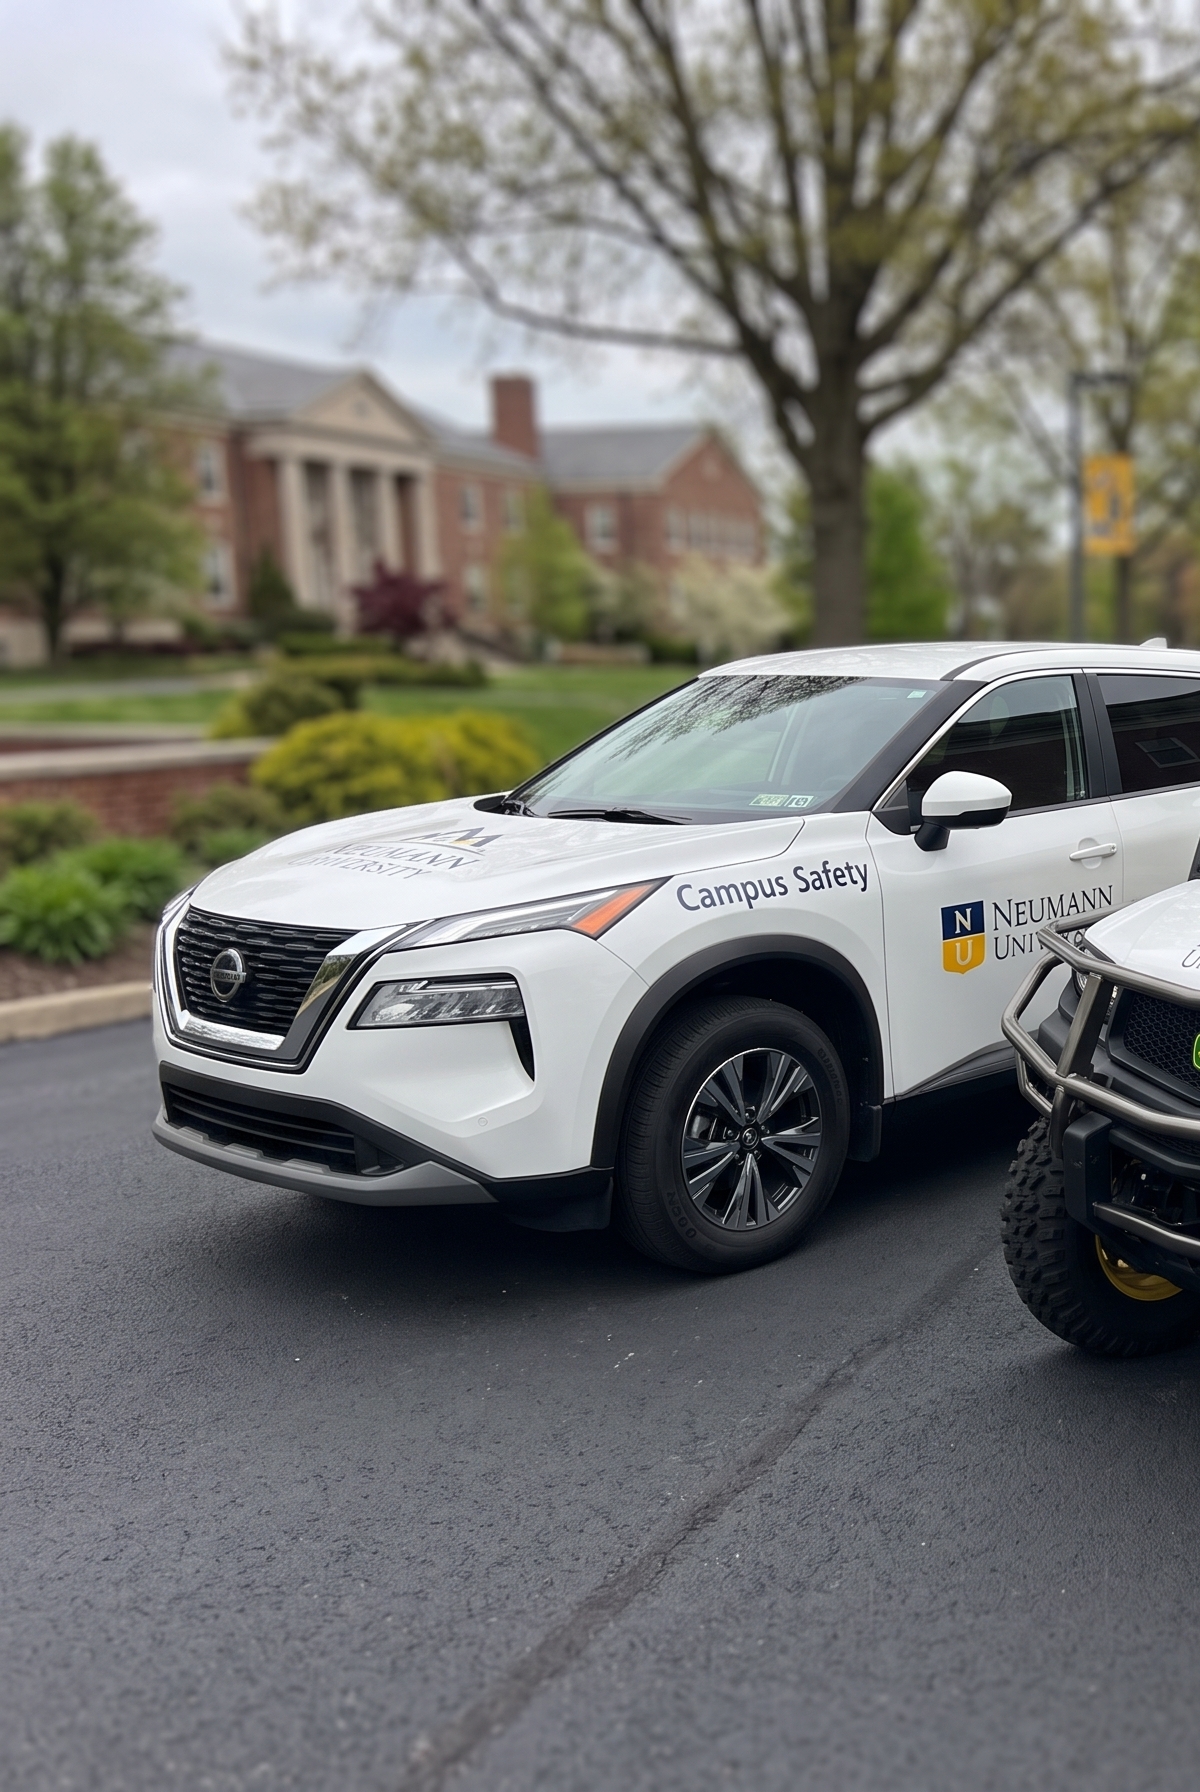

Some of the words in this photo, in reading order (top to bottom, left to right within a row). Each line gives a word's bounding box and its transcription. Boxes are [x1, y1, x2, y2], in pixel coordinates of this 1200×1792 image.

[676, 875, 789, 912] Campus
[792, 860, 868, 893] Safety
[954, 907, 973, 934] N
[991, 885, 1113, 931] NEUMANN
[955, 940, 973, 966] U
[994, 931, 1044, 960] UNI
